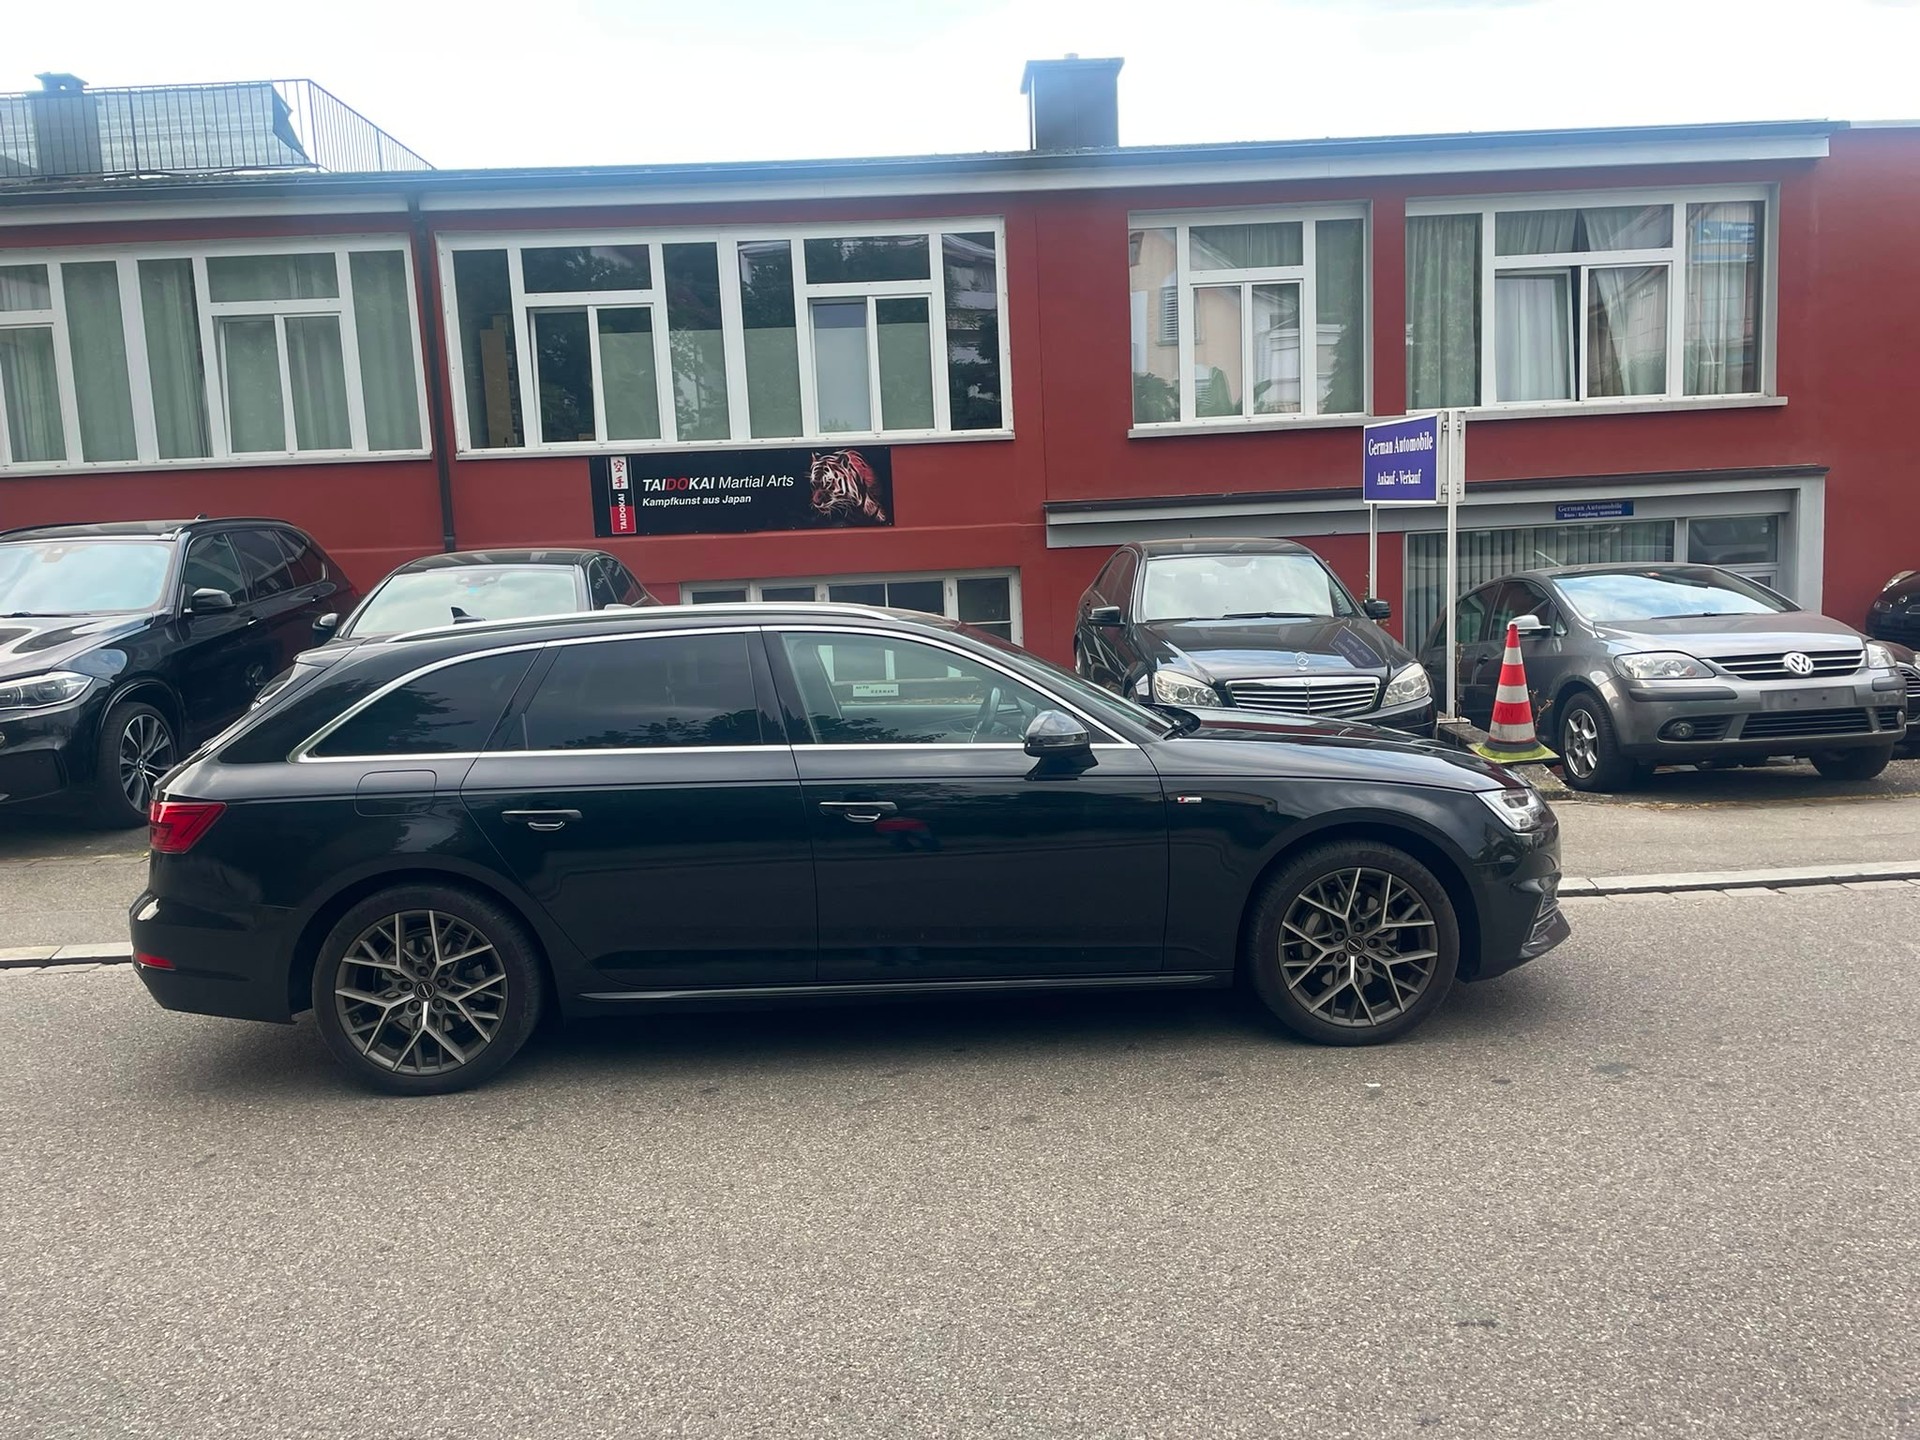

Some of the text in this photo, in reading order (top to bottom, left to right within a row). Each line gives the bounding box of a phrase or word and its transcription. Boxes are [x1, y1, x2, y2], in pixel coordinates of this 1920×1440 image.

[1368, 431, 1433, 456] German Automobile
[643, 474, 795, 491] TAIDOKAI Martial Arts
[1376, 470, 1396, 485] Ankauf
[1399, 469, 1422, 485] Verkauf
[642, 494, 752, 508] Kampfkunst aus Japan
[1585, 502, 1622, 511] Automobile
[617, 493, 628, 531] TAIDOKAI
